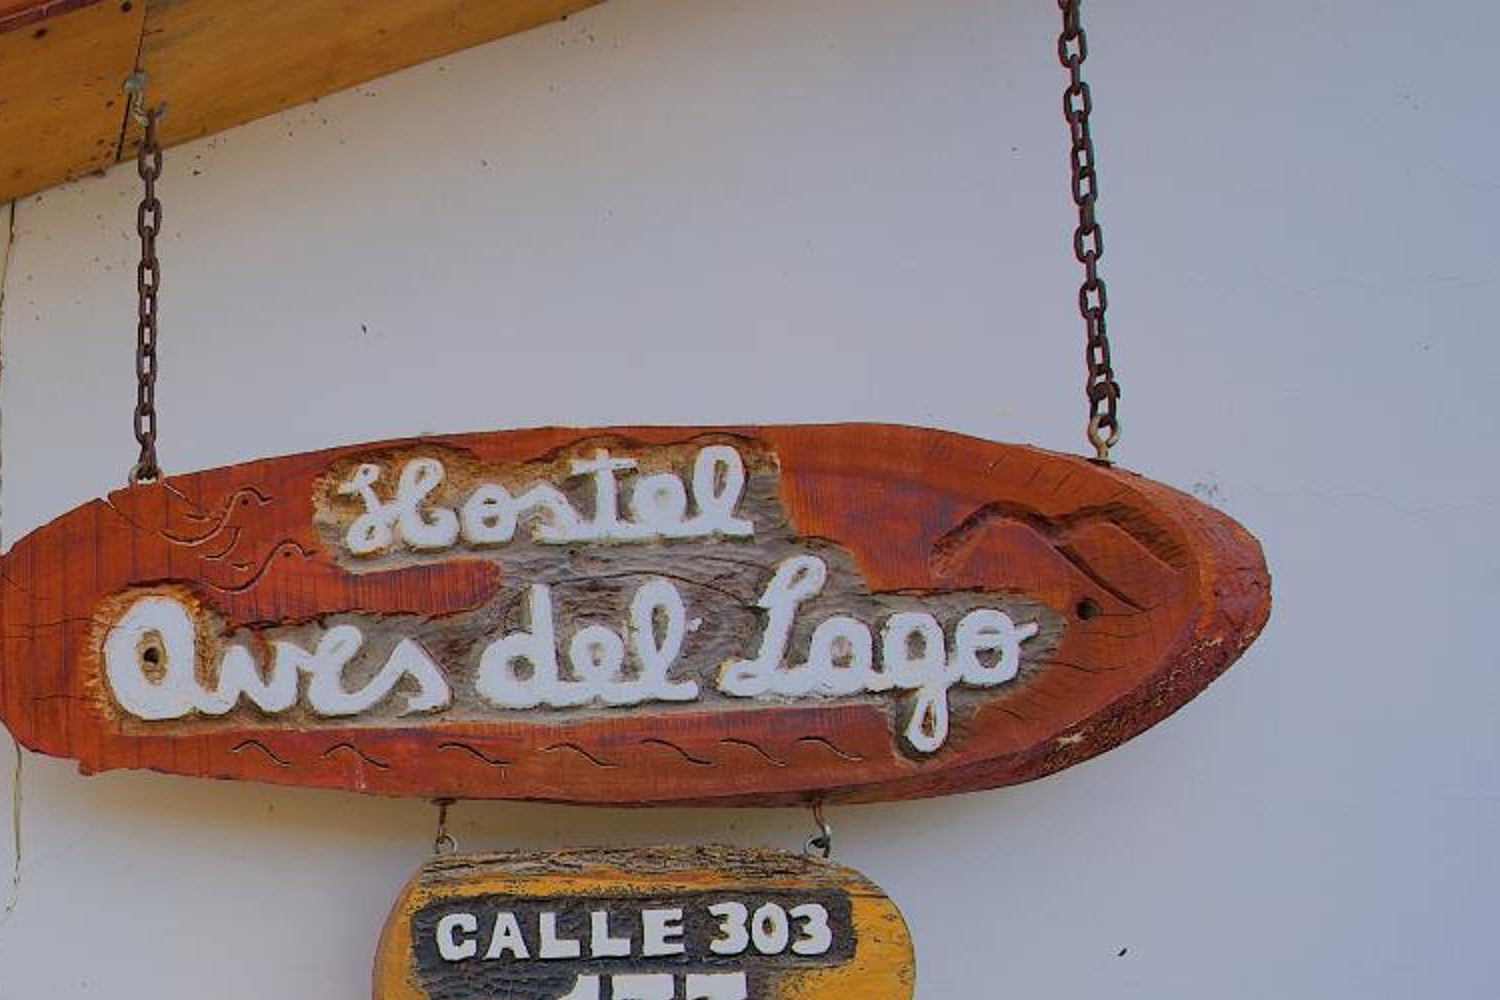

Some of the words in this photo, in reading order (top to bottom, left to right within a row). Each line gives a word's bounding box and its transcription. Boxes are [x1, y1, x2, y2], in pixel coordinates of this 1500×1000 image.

[338, 446, 754, 556] Hostel
[476, 580, 701, 709] del
[717, 556, 1040, 753] Lago
[436, 907, 686, 961] CALLE
[708, 902, 833, 956] 303
